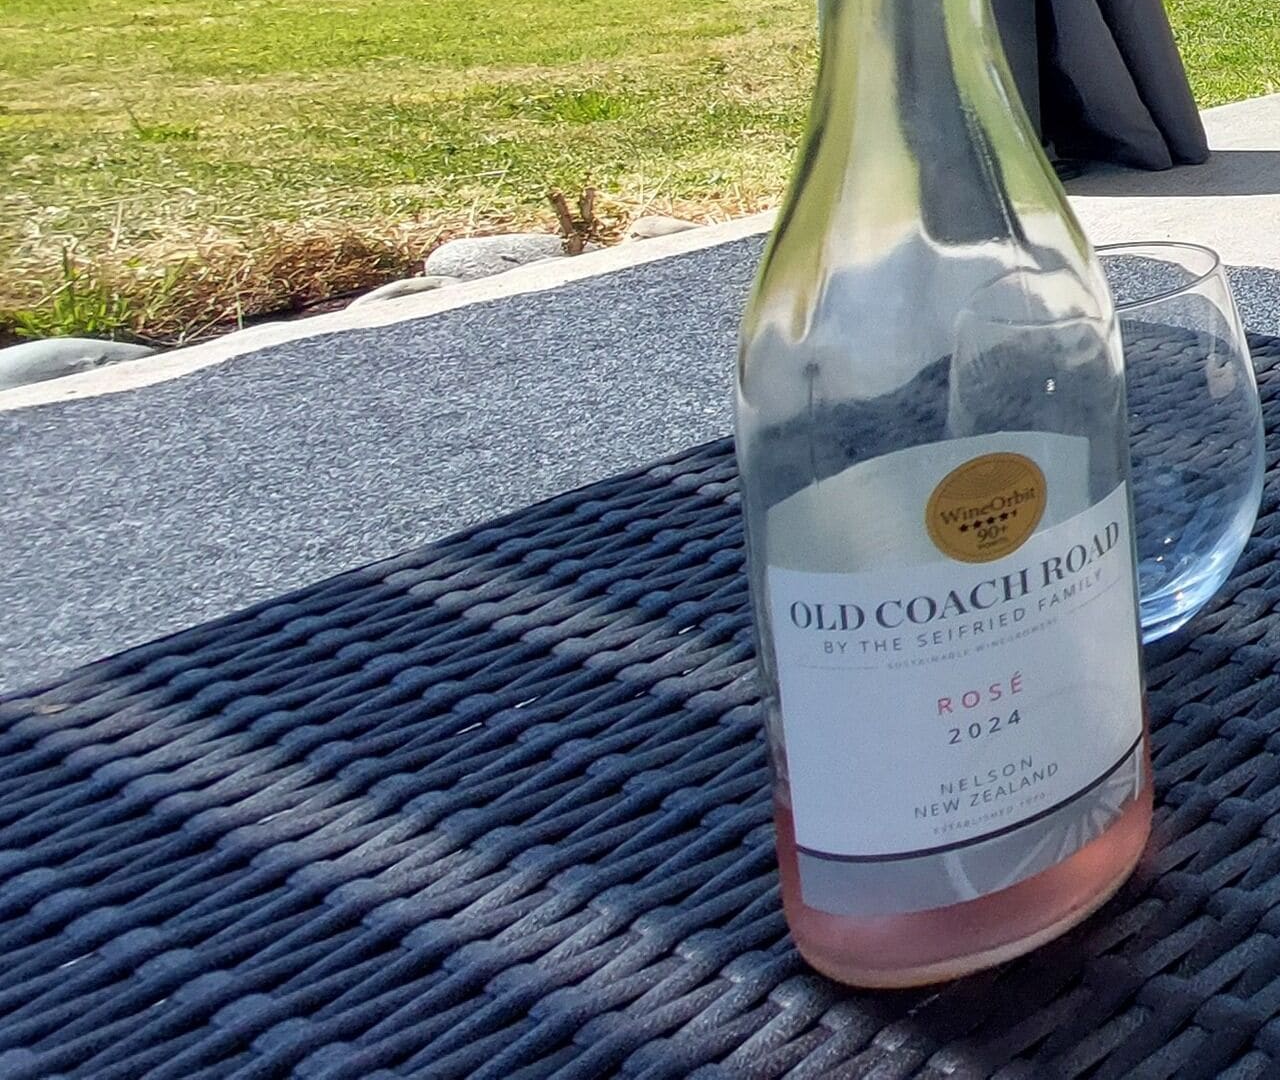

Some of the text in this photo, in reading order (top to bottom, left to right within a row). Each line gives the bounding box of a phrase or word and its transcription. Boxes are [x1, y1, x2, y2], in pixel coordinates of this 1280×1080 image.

[940, 487, 1035, 525] WineOrbit
[789, 521, 1120, 632] OLD COACH ROAD
[823, 567, 1103, 655] BY THE SEIFRIED FAMILY
[937, 670, 1024, 716] ROSÉ
[949, 708, 1022, 745] 2024
[914, 798, 961, 820] NEW
[969, 761, 1060, 808] ZEALAND
[940, 754, 1034, 796] NELSON
